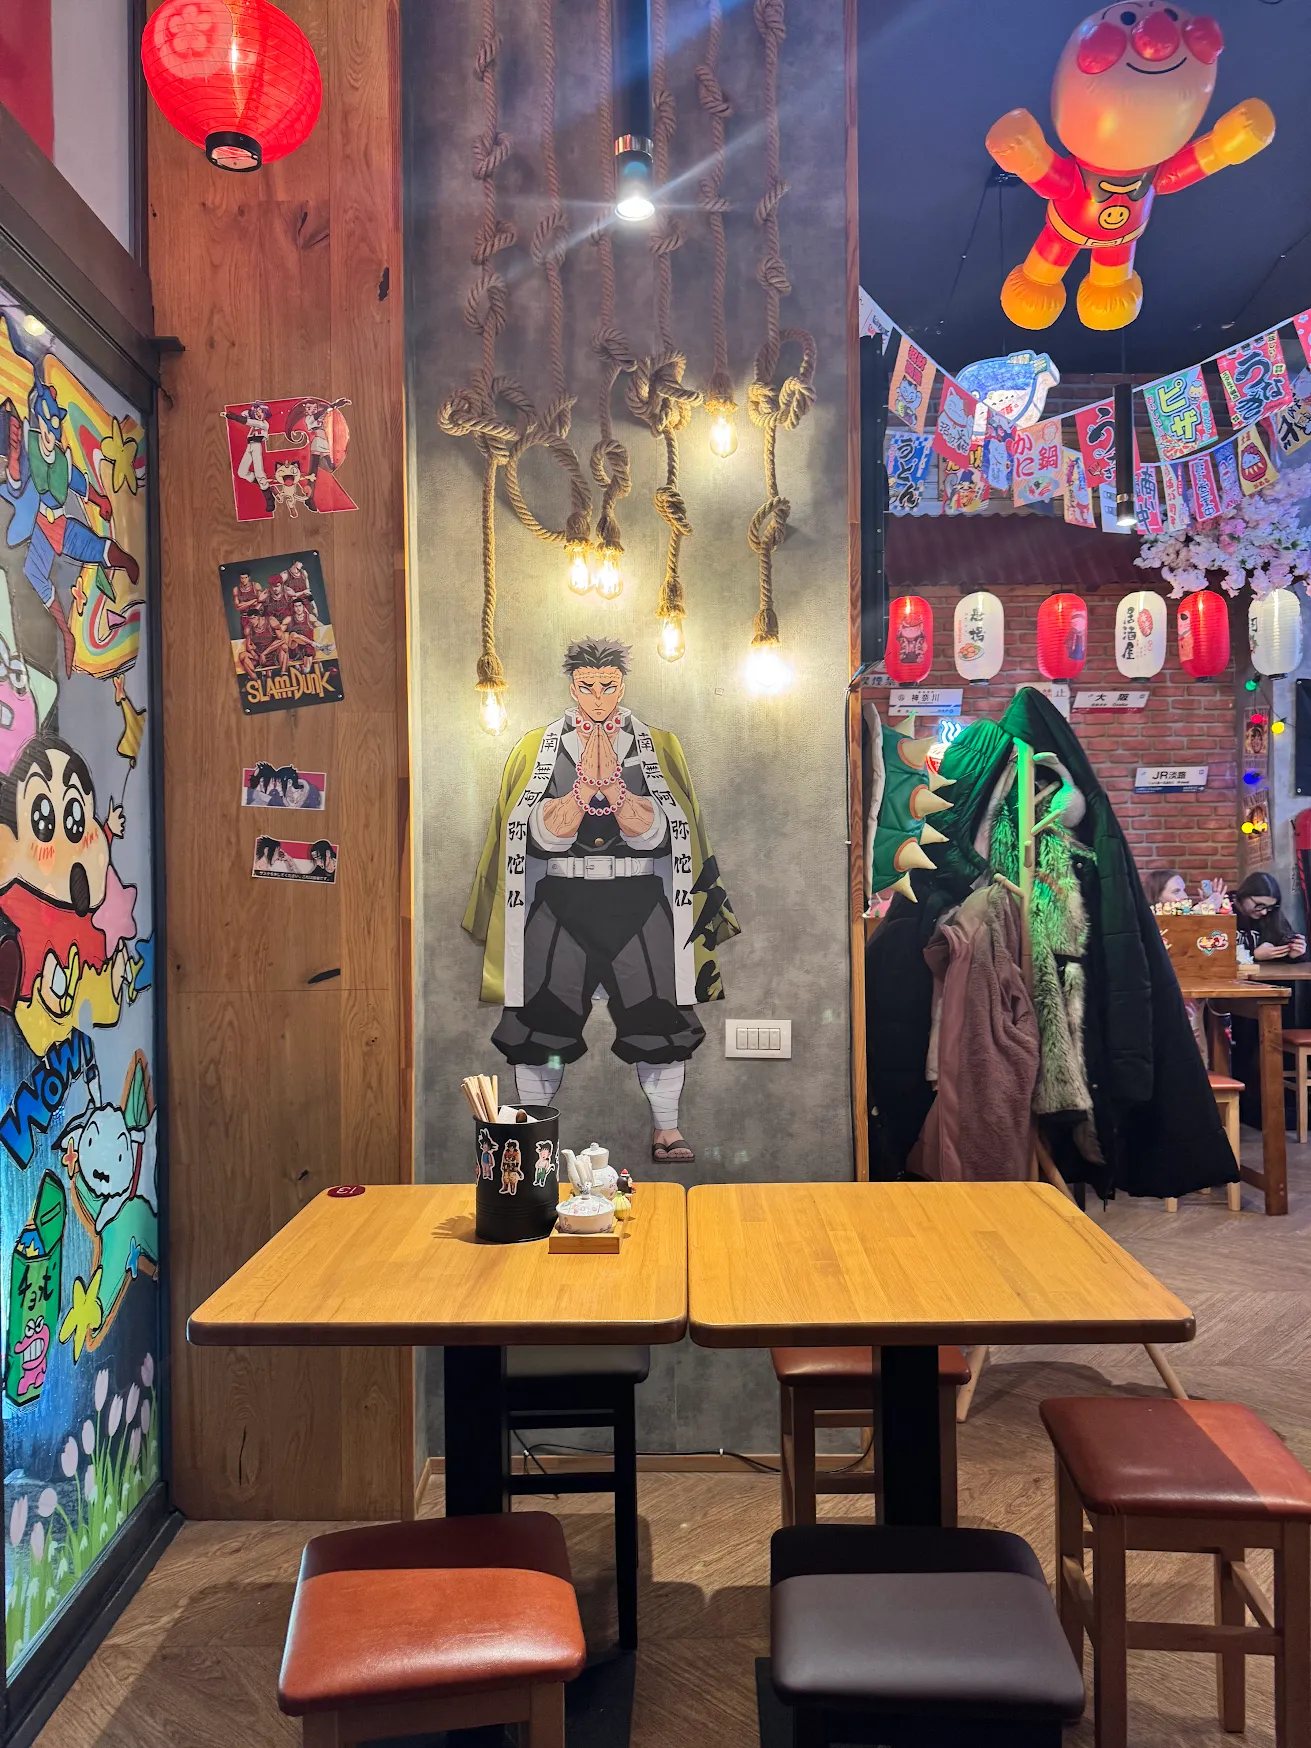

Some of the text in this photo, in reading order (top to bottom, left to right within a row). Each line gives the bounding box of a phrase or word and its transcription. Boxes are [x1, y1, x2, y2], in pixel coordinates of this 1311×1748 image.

[1158, 379, 1198, 440] ピザ
[897, 438, 919, 508] うどん
[1012, 433, 1034, 478] かに
[1036, 443, 1058, 472] 鍋
[1122, 606, 1137, 660] 居酒屋
[1094, 693, 1130, 702] 大阪
